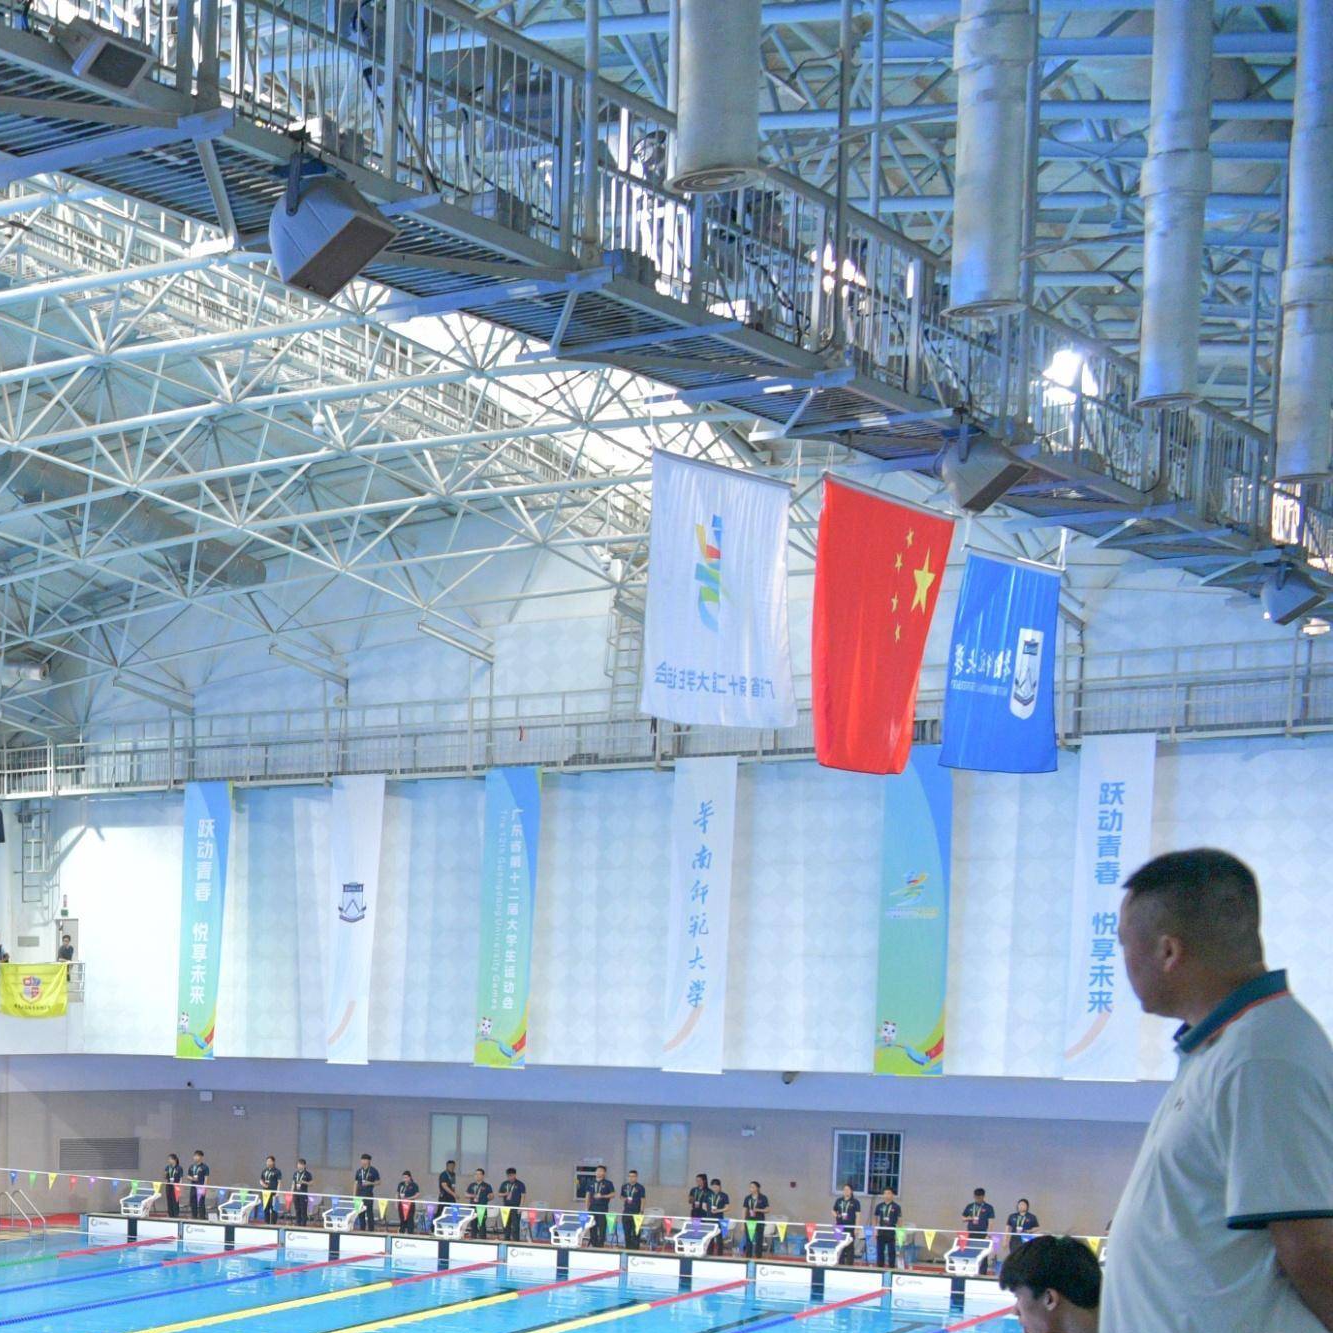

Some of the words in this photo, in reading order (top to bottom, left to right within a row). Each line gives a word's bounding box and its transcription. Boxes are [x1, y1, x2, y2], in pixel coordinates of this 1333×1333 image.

[194, 819, 216, 902] 跃动青春
[1095, 782, 1126, 885] 跃动青春
[189, 922, 209, 1005] 悦享未来
[1087, 912, 1118, 1014] 悦享未来
